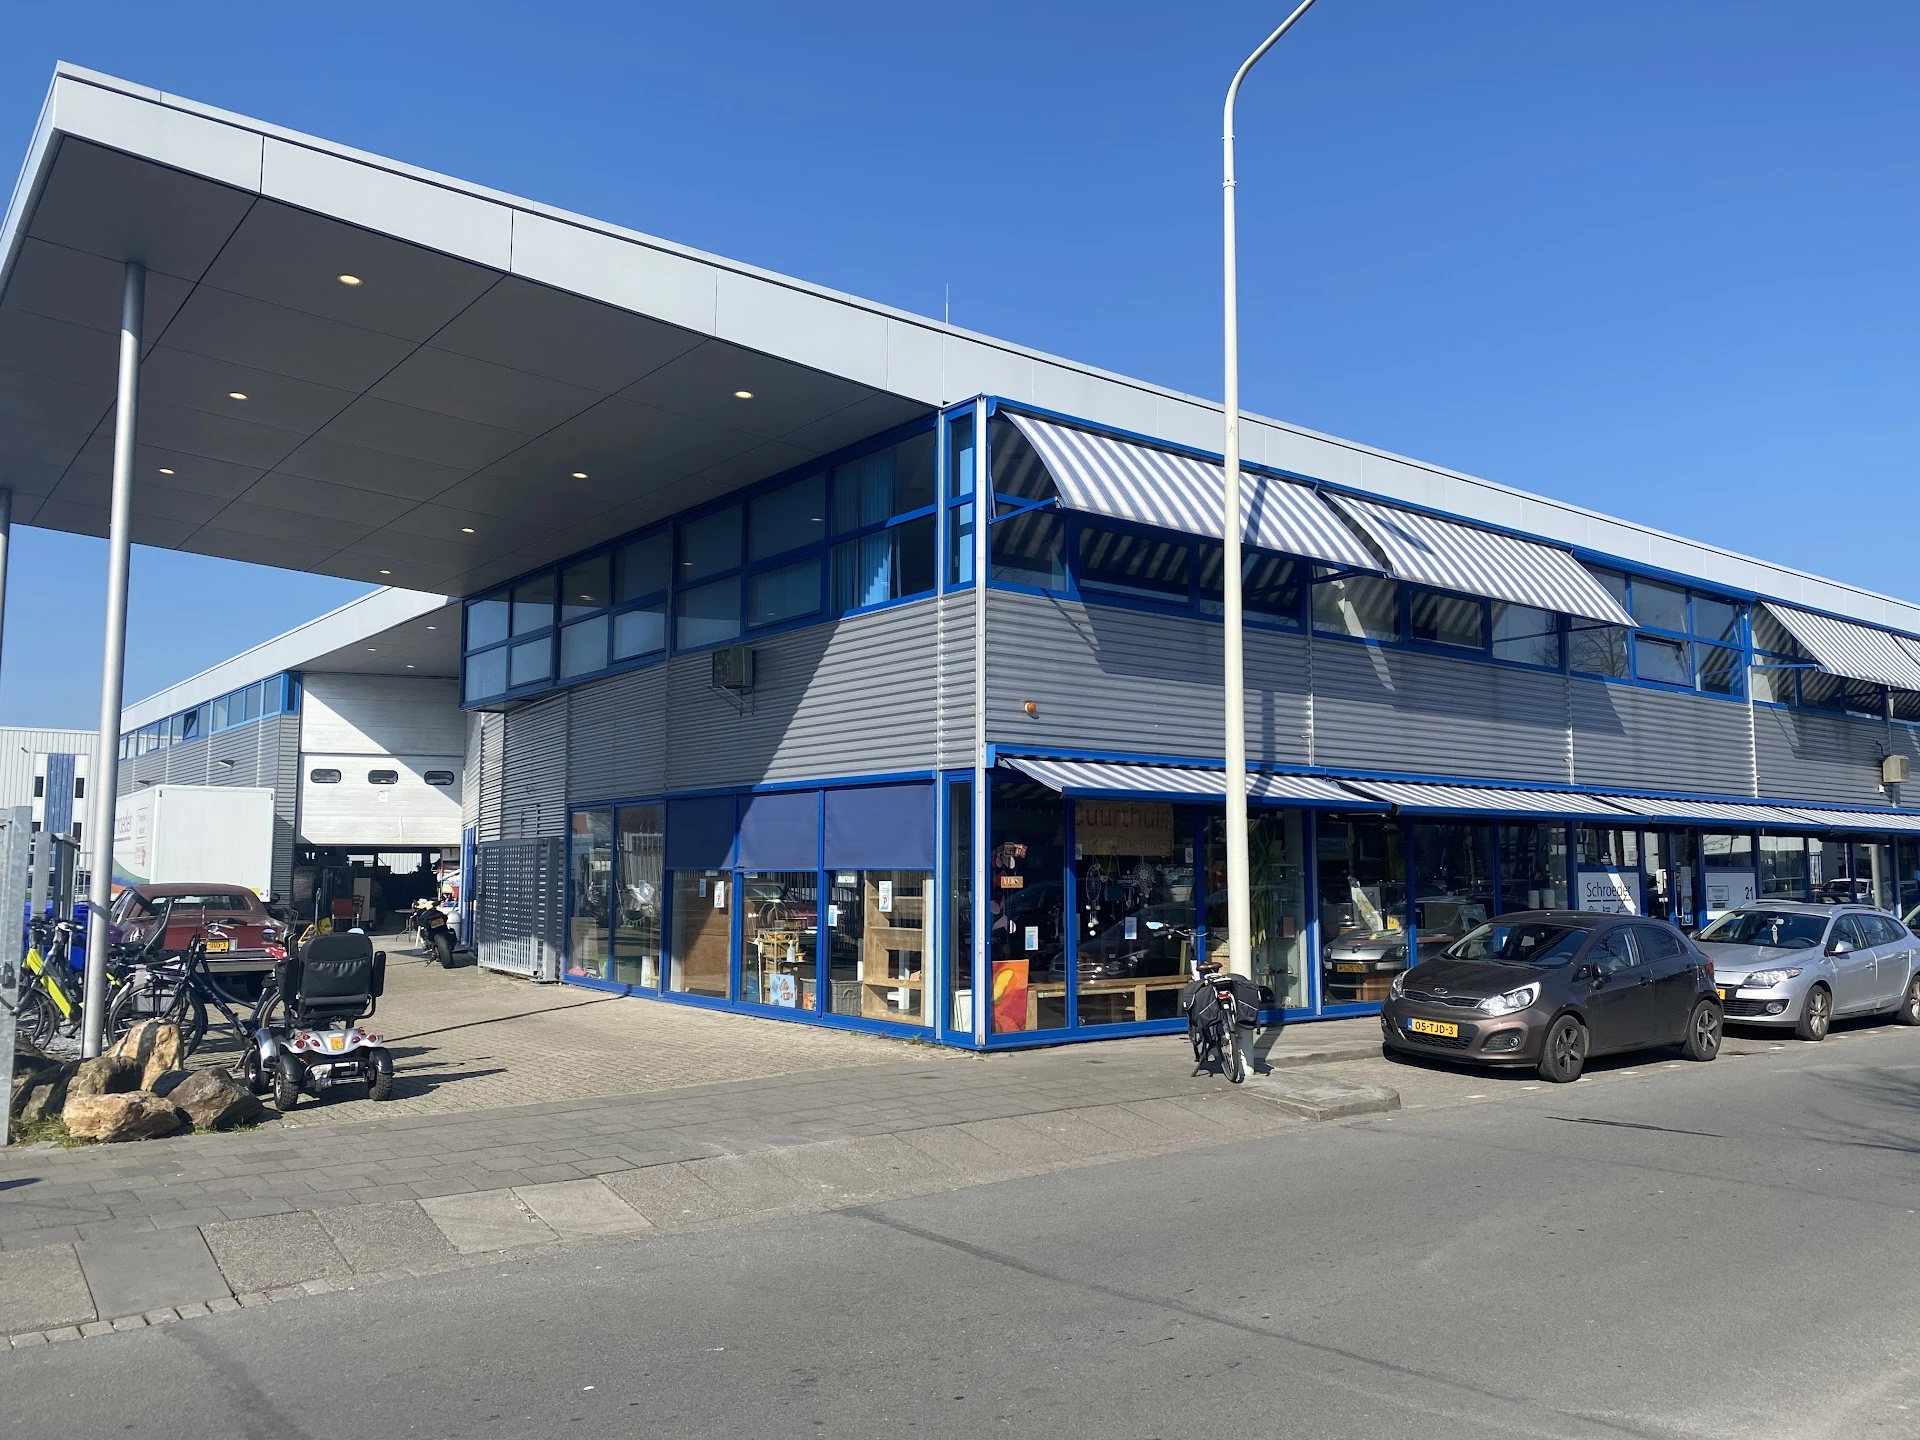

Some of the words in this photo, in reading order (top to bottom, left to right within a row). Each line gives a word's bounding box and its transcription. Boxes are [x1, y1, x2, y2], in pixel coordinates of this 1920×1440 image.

[1586, 881, 1631, 897] Schroeder
[1744, 886, 1754, 900] 21
[1415, 1021, 1454, 1035] 05-TJD-3
